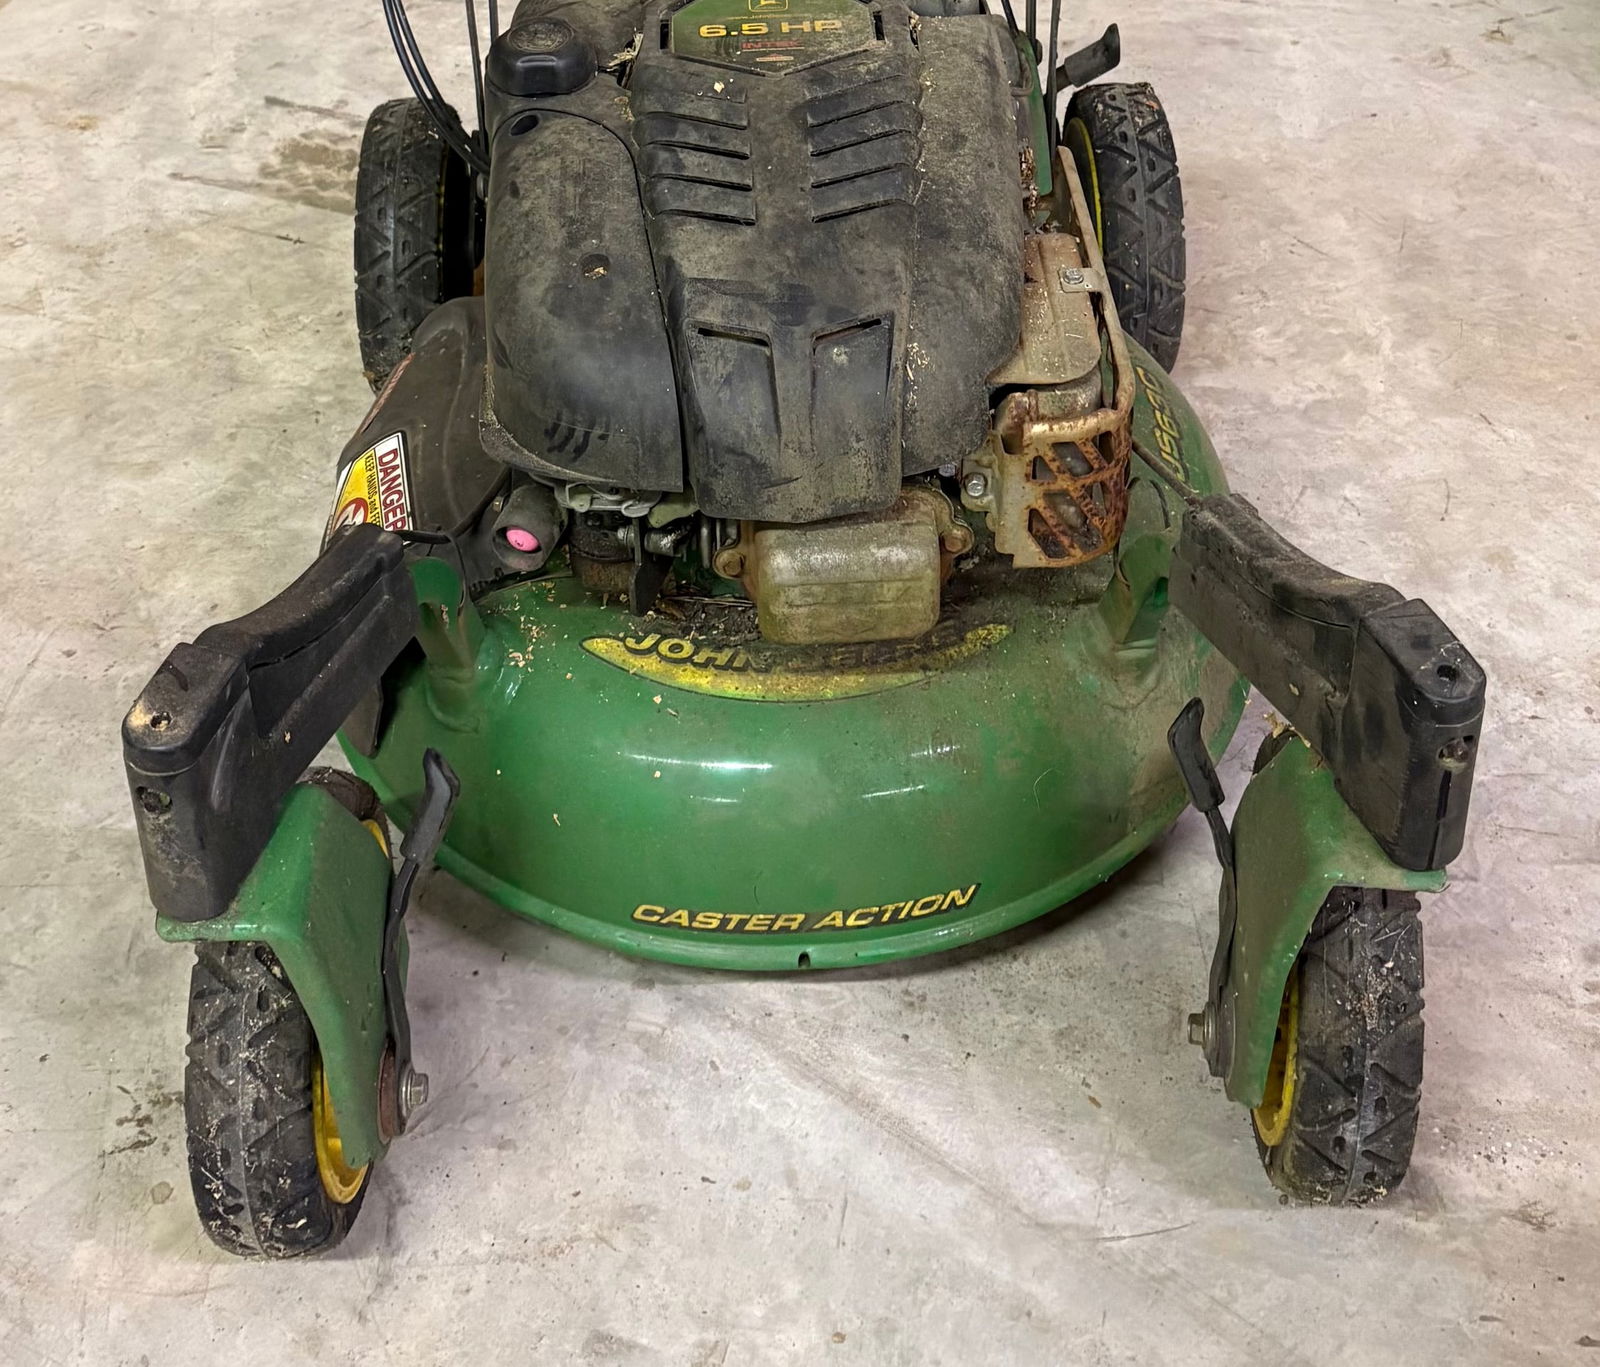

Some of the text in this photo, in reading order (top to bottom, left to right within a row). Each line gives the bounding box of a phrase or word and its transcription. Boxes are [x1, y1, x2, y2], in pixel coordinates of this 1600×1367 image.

[698, 20, 843, 38] 6.5 HP
[364, 453, 375, 472] KEEP
[366, 473, 378, 499] HANDS
[377, 448, 407, 531] DANGER
[369, 511, 381, 527] FEE
[631, 883, 982, 934] CASTER ACTION
